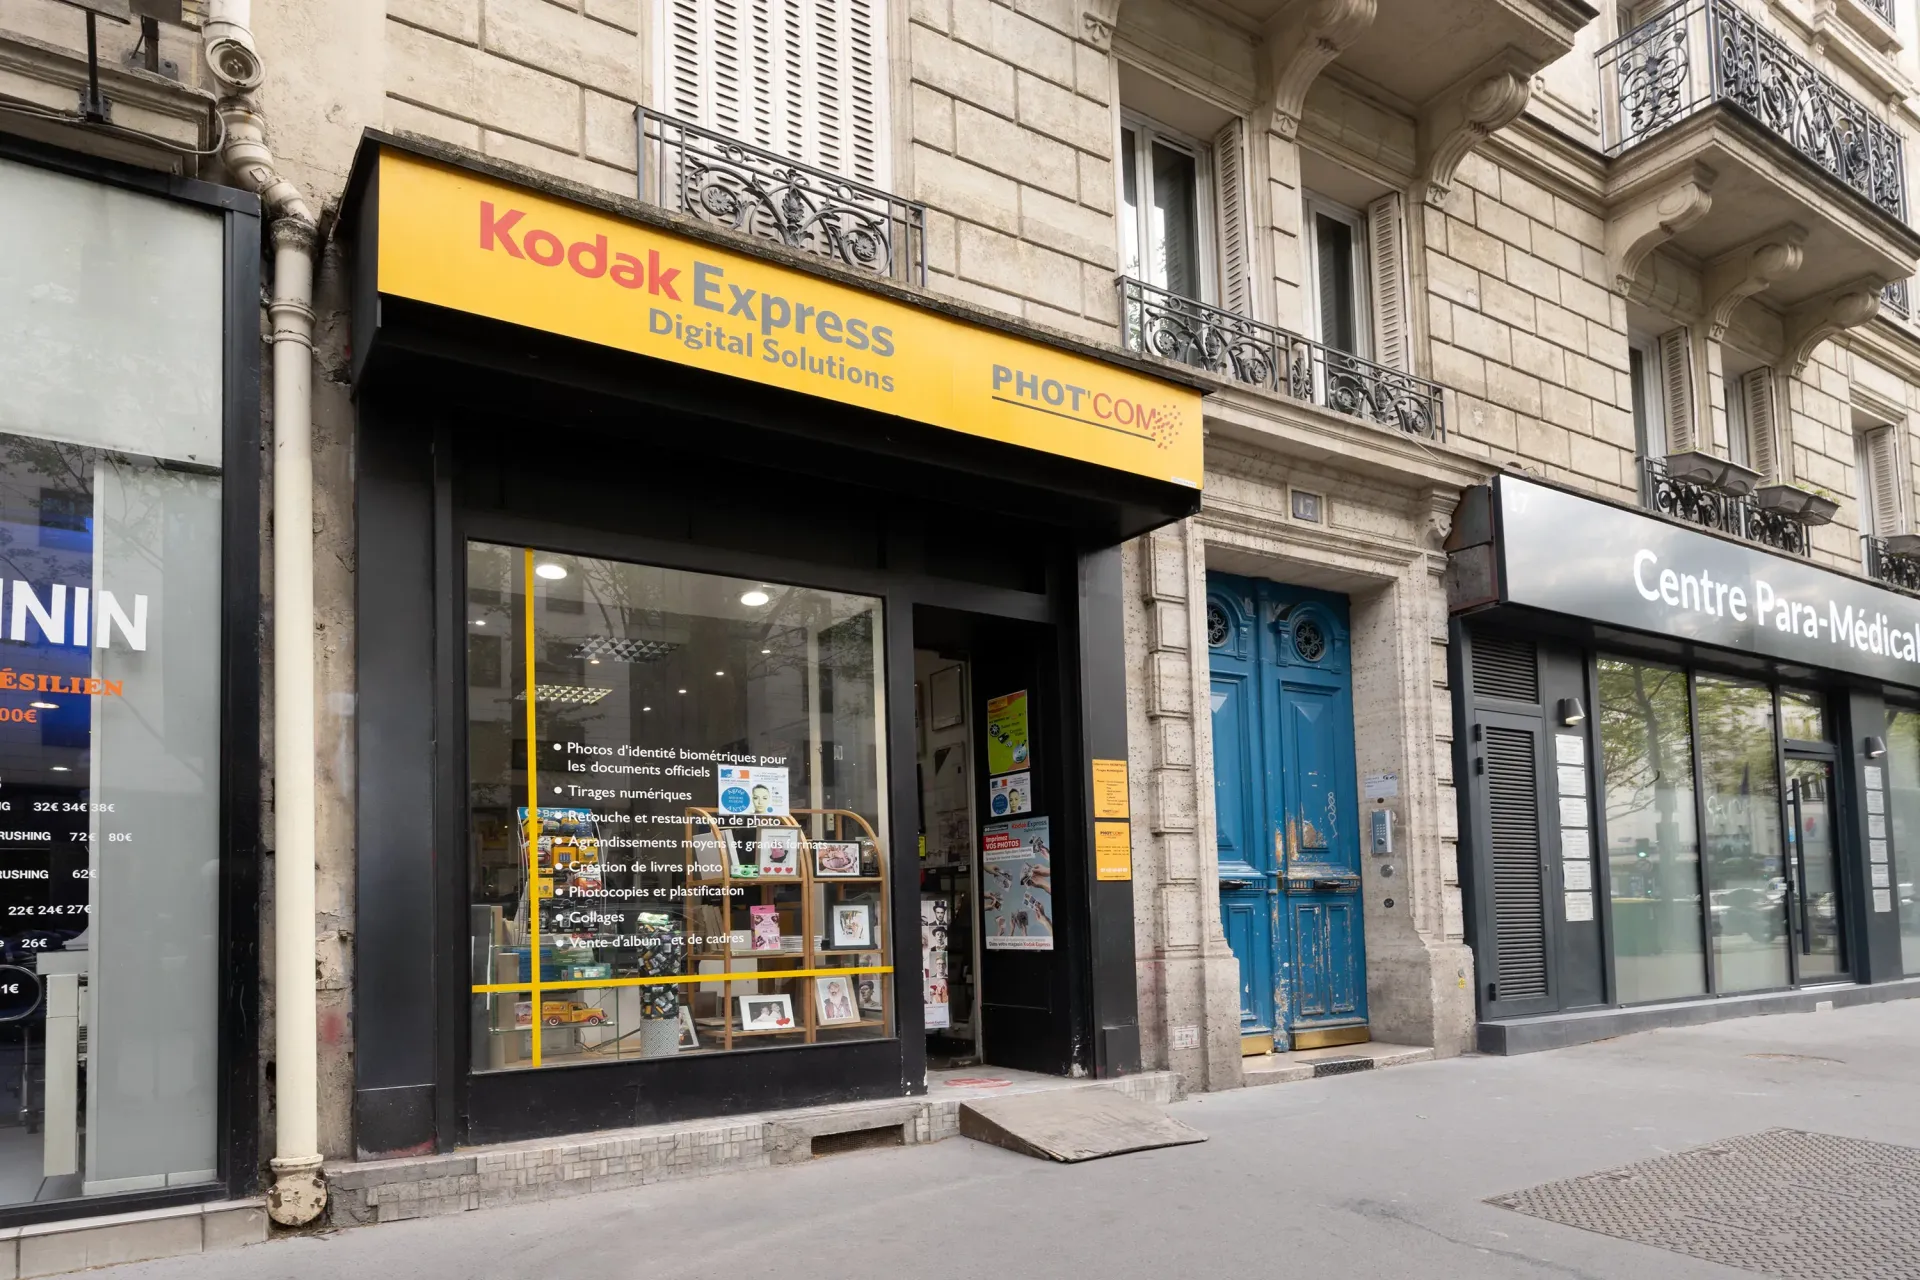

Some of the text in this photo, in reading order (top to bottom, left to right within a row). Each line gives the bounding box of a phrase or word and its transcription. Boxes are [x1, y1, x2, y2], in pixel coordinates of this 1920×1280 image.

[479, 200, 895, 357] Kodak Express
[648, 307, 895, 393] Digital Solutions
[992, 363, 1157, 431] PHOT'COM
[1633, 549, 1920, 664] Centre Para-Médical
[567, 741, 787, 766] Photos d'identité biométriques pour
[567, 759, 711, 778] les documents officiels
[567, 784, 692, 803] Tirages numériques
[33, 802, 59, 812] 32€
[62, 802, 87, 812] 34€
[91, 803, 115, 813] 38€
[568, 810, 631, 823] Retouche
[634, 813, 648, 824] et
[651, 815, 725, 826] restauration
[728, 814, 743, 825] de
[746, 815, 781, 827] photo
[69, 832, 97, 842] 72€
[108, 832, 133, 842] 80€
[568, 835, 828, 851] Agrandissements moyens et grands formats
[986, 840, 1019, 850] VOS PHOTOS
[72, 869, 97, 879] 62€
[568, 860, 723, 875] Création de livres photo
[569, 885, 745, 901] Photocopies et plastification
[8, 904, 92, 916] 22€ 24€ 27€
[569, 910, 625, 926] Collages
[21, 938, 48, 948] 26€
[569, 932, 745, 949] Vente d'album et de cadres
